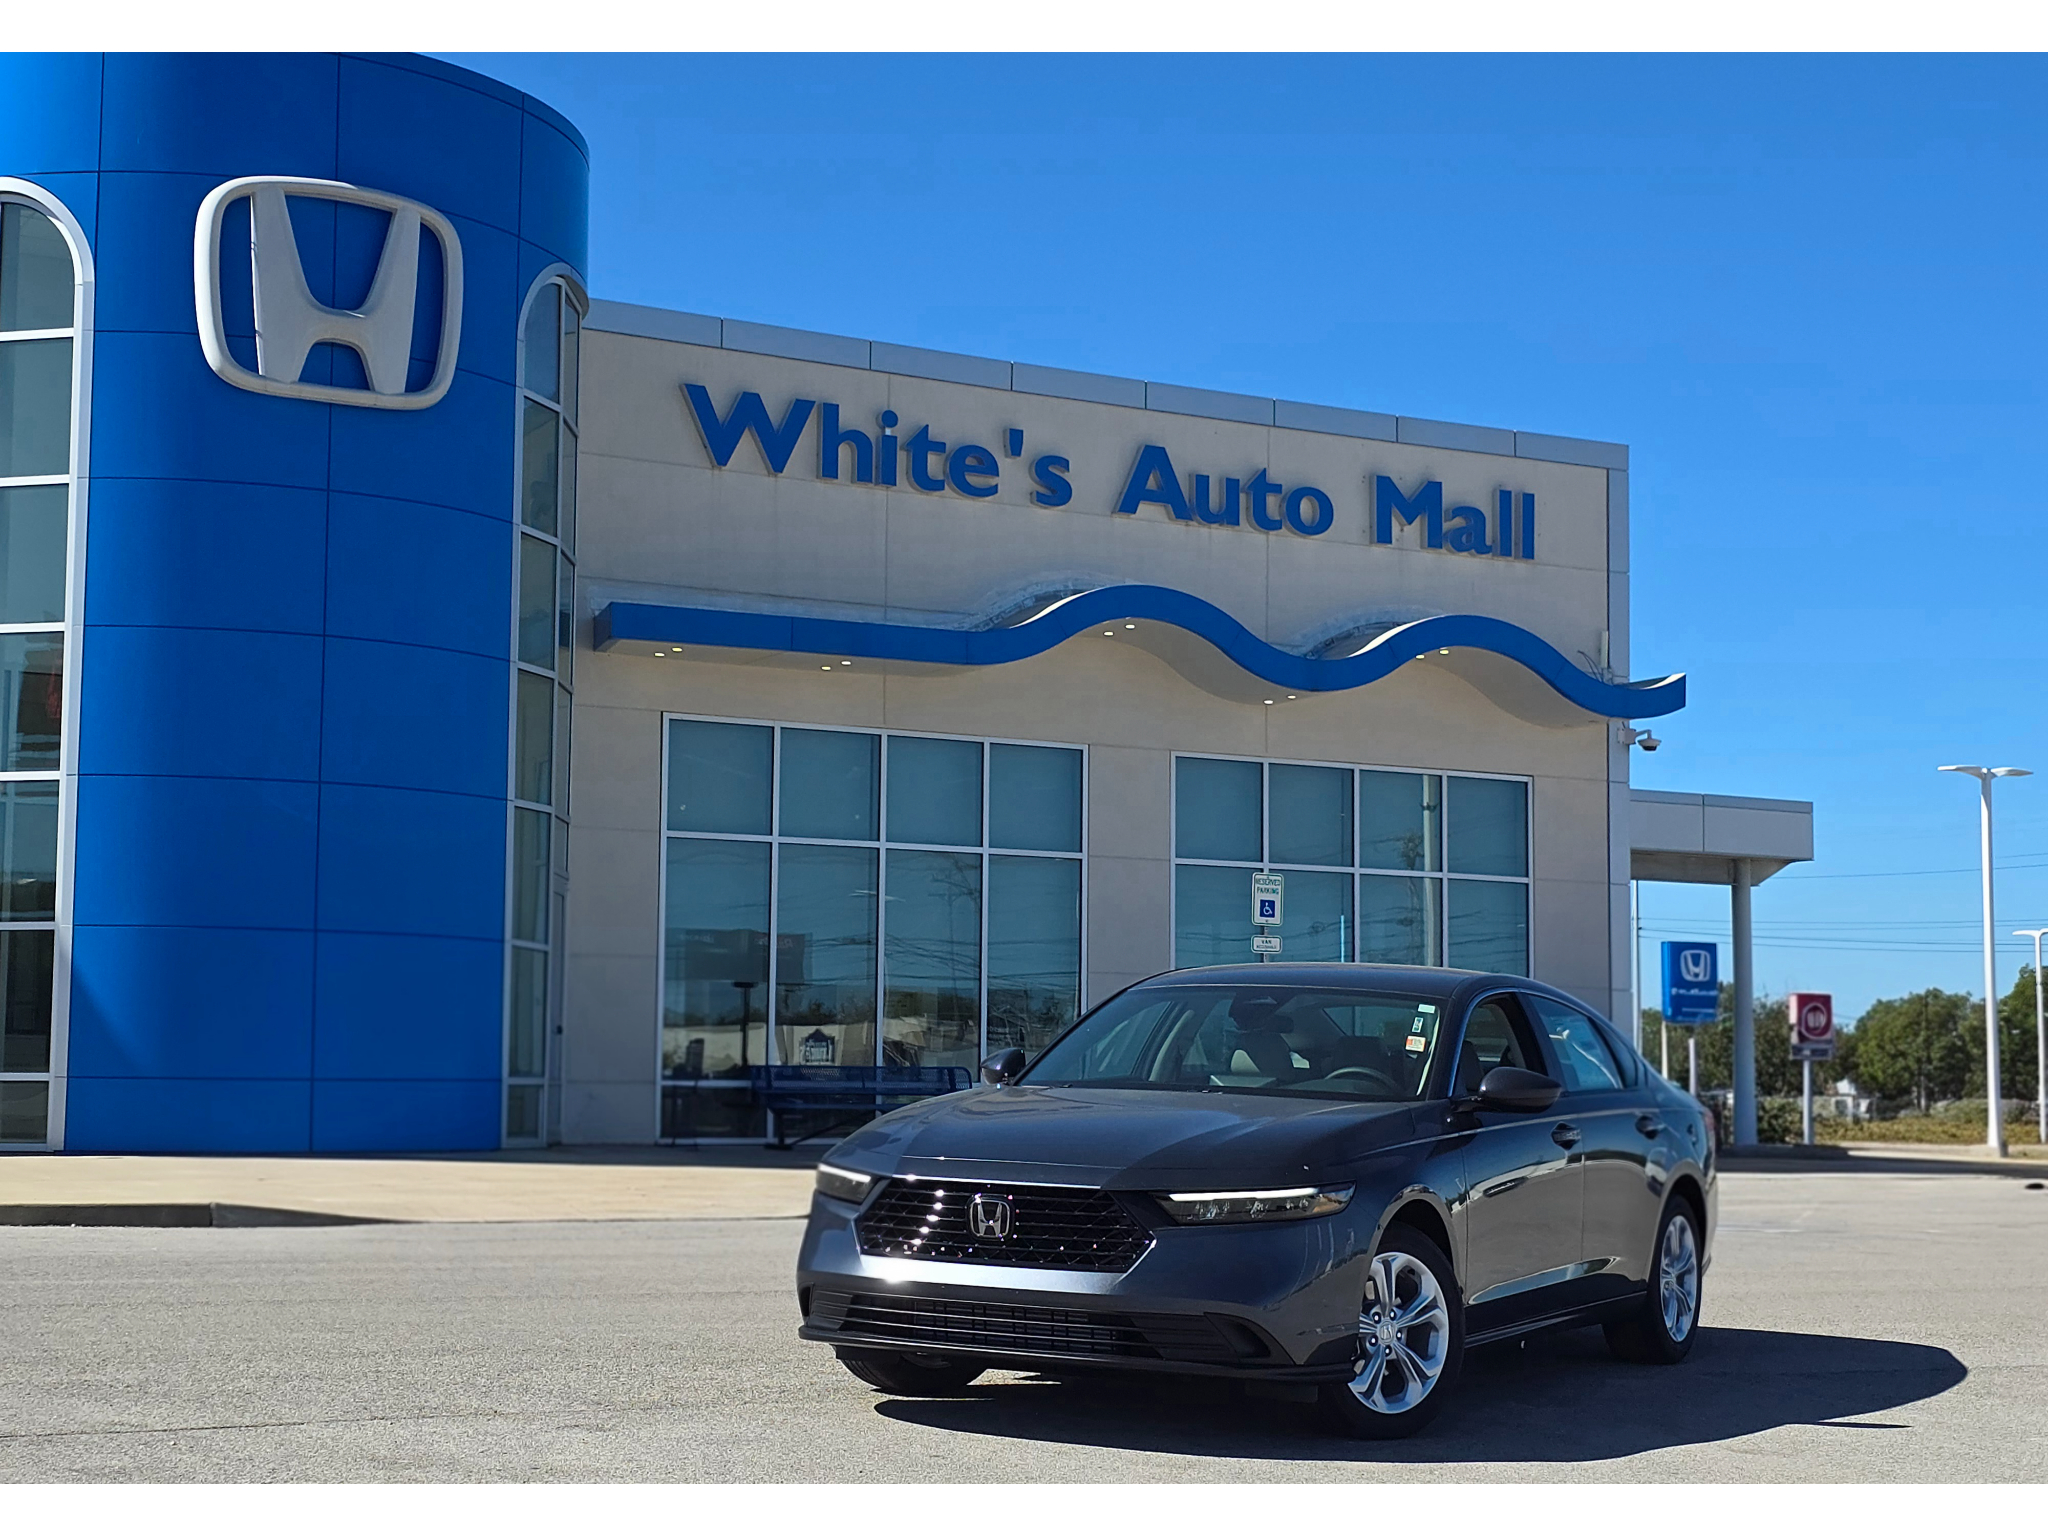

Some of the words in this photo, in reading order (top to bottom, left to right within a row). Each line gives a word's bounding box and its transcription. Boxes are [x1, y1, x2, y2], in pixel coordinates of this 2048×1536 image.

[679, 382, 1073, 509] White's
[1113, 443, 1335, 537] Auto
[1371, 474, 1536, 561] Mall
[1257, 887, 1279, 895] PARKING
